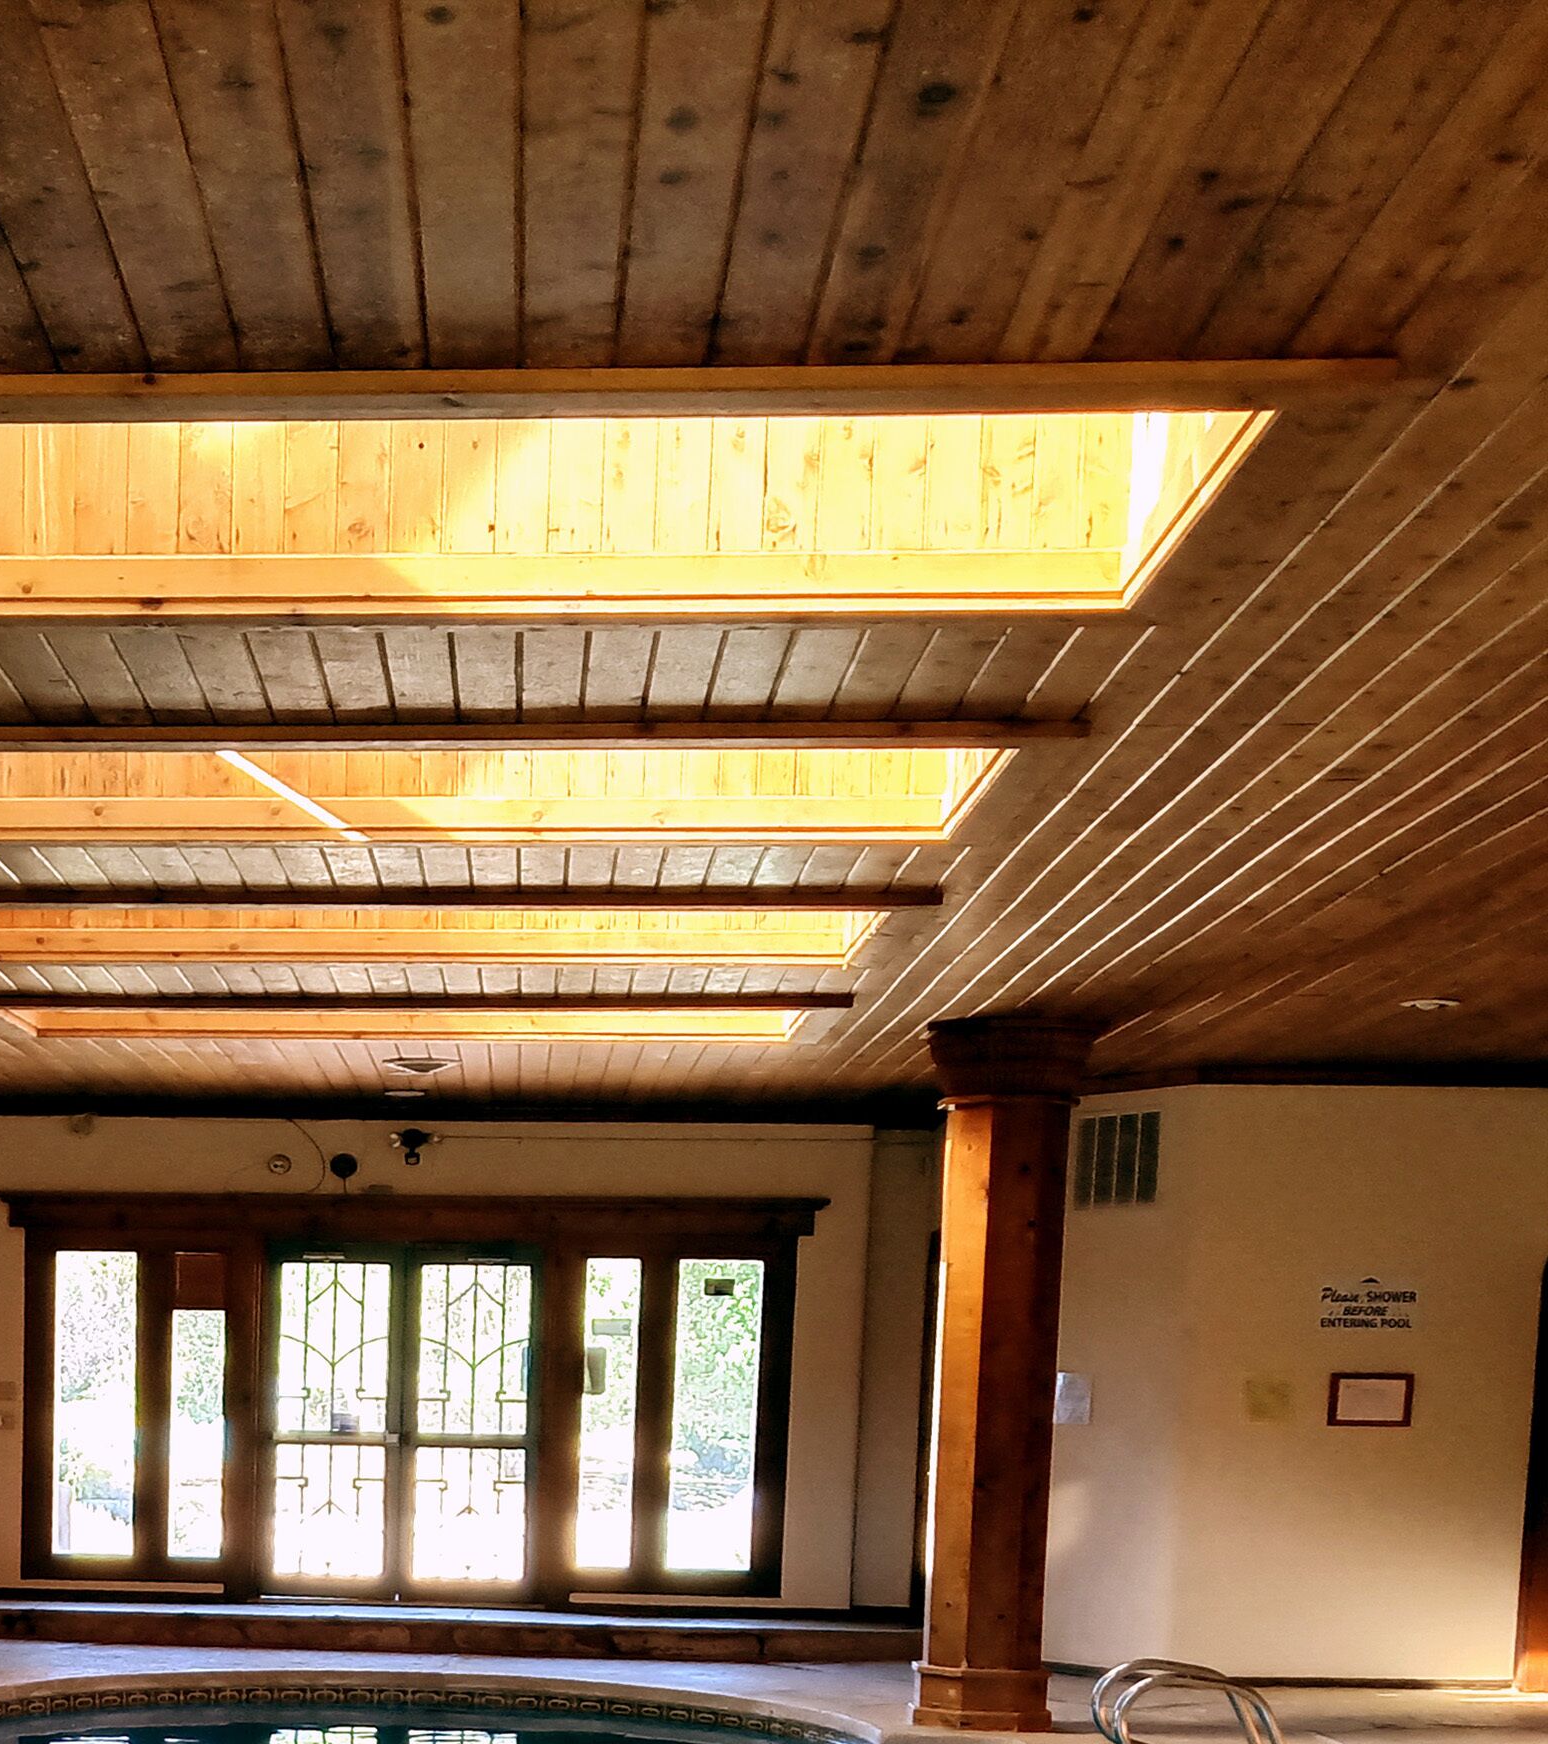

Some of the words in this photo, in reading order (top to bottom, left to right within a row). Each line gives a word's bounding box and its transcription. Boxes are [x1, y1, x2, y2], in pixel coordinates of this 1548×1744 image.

[1366, 1290, 1417, 1303] SHOWER
[1343, 1306, 1388, 1316] BEFORE
[1320, 1317, 1378, 1329] ENTERING
[1380, 1317, 1413, 1329] POOL
